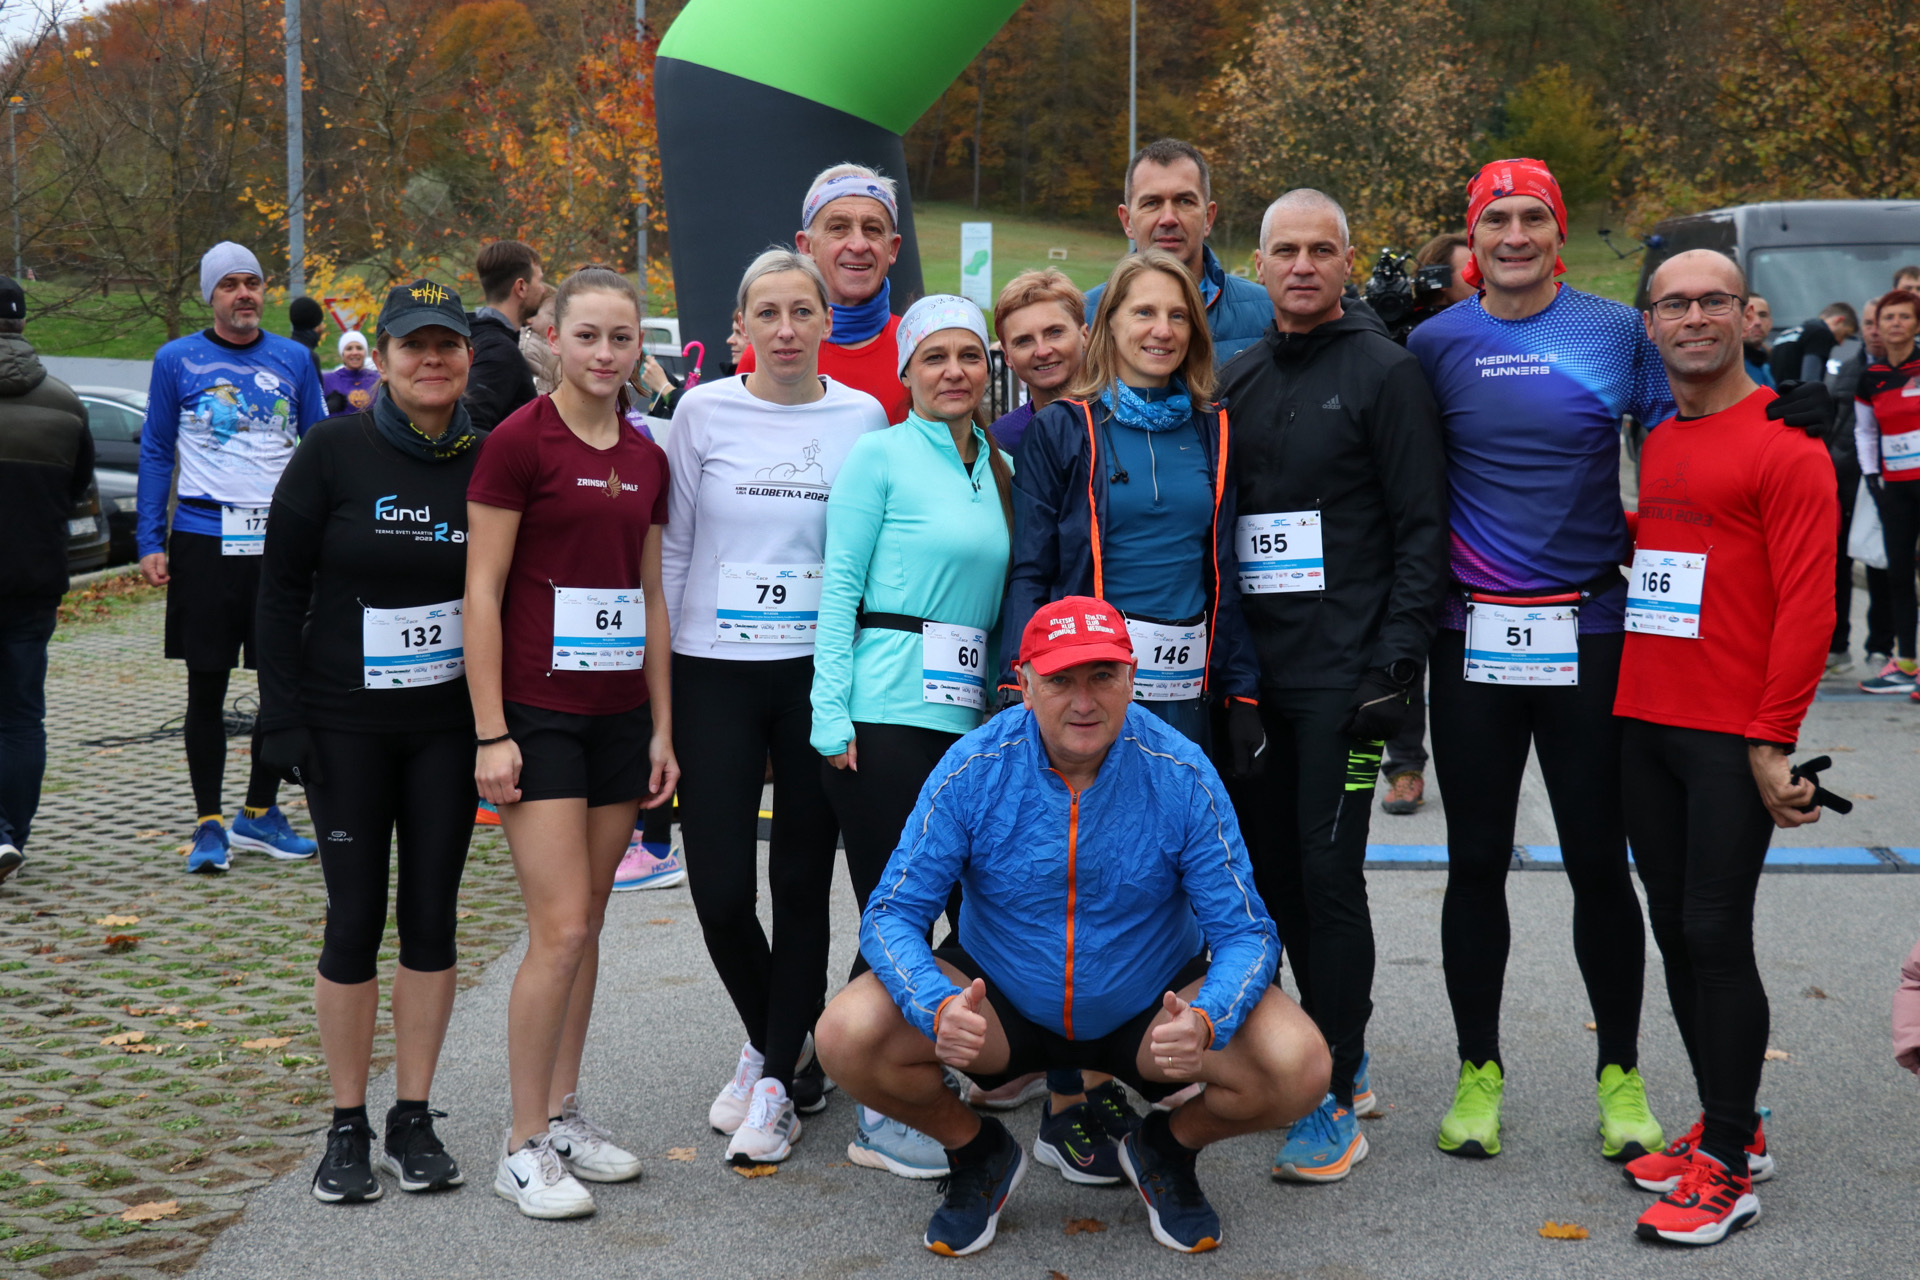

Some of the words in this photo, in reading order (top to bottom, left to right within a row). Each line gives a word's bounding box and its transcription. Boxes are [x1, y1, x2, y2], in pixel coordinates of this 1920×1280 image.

[1481, 365, 1550, 378] RUNNERS
[576, 478, 608, 489] ZRINSKI
[621, 482, 638, 492] HALF
[748, 487, 802, 499] GLOBETKA
[803, 491, 829, 503] 2022
[375, 494, 431, 523] Fund
[1675, 508, 1713, 527] 2023
[245, 517, 268, 531] 177
[434, 522, 469, 544] Ra
[1250, 533, 1288, 555] 155
[1641, 571, 1671, 594] 166
[756, 584, 787, 605] 79
[595, 609, 623, 631] 64
[401, 624, 442, 648] 132
[1506, 627, 1532, 647] 51
[958, 646, 979, 669] 60
[1153, 645, 1191, 665] 146
[651, 858, 677, 874] HOKA
